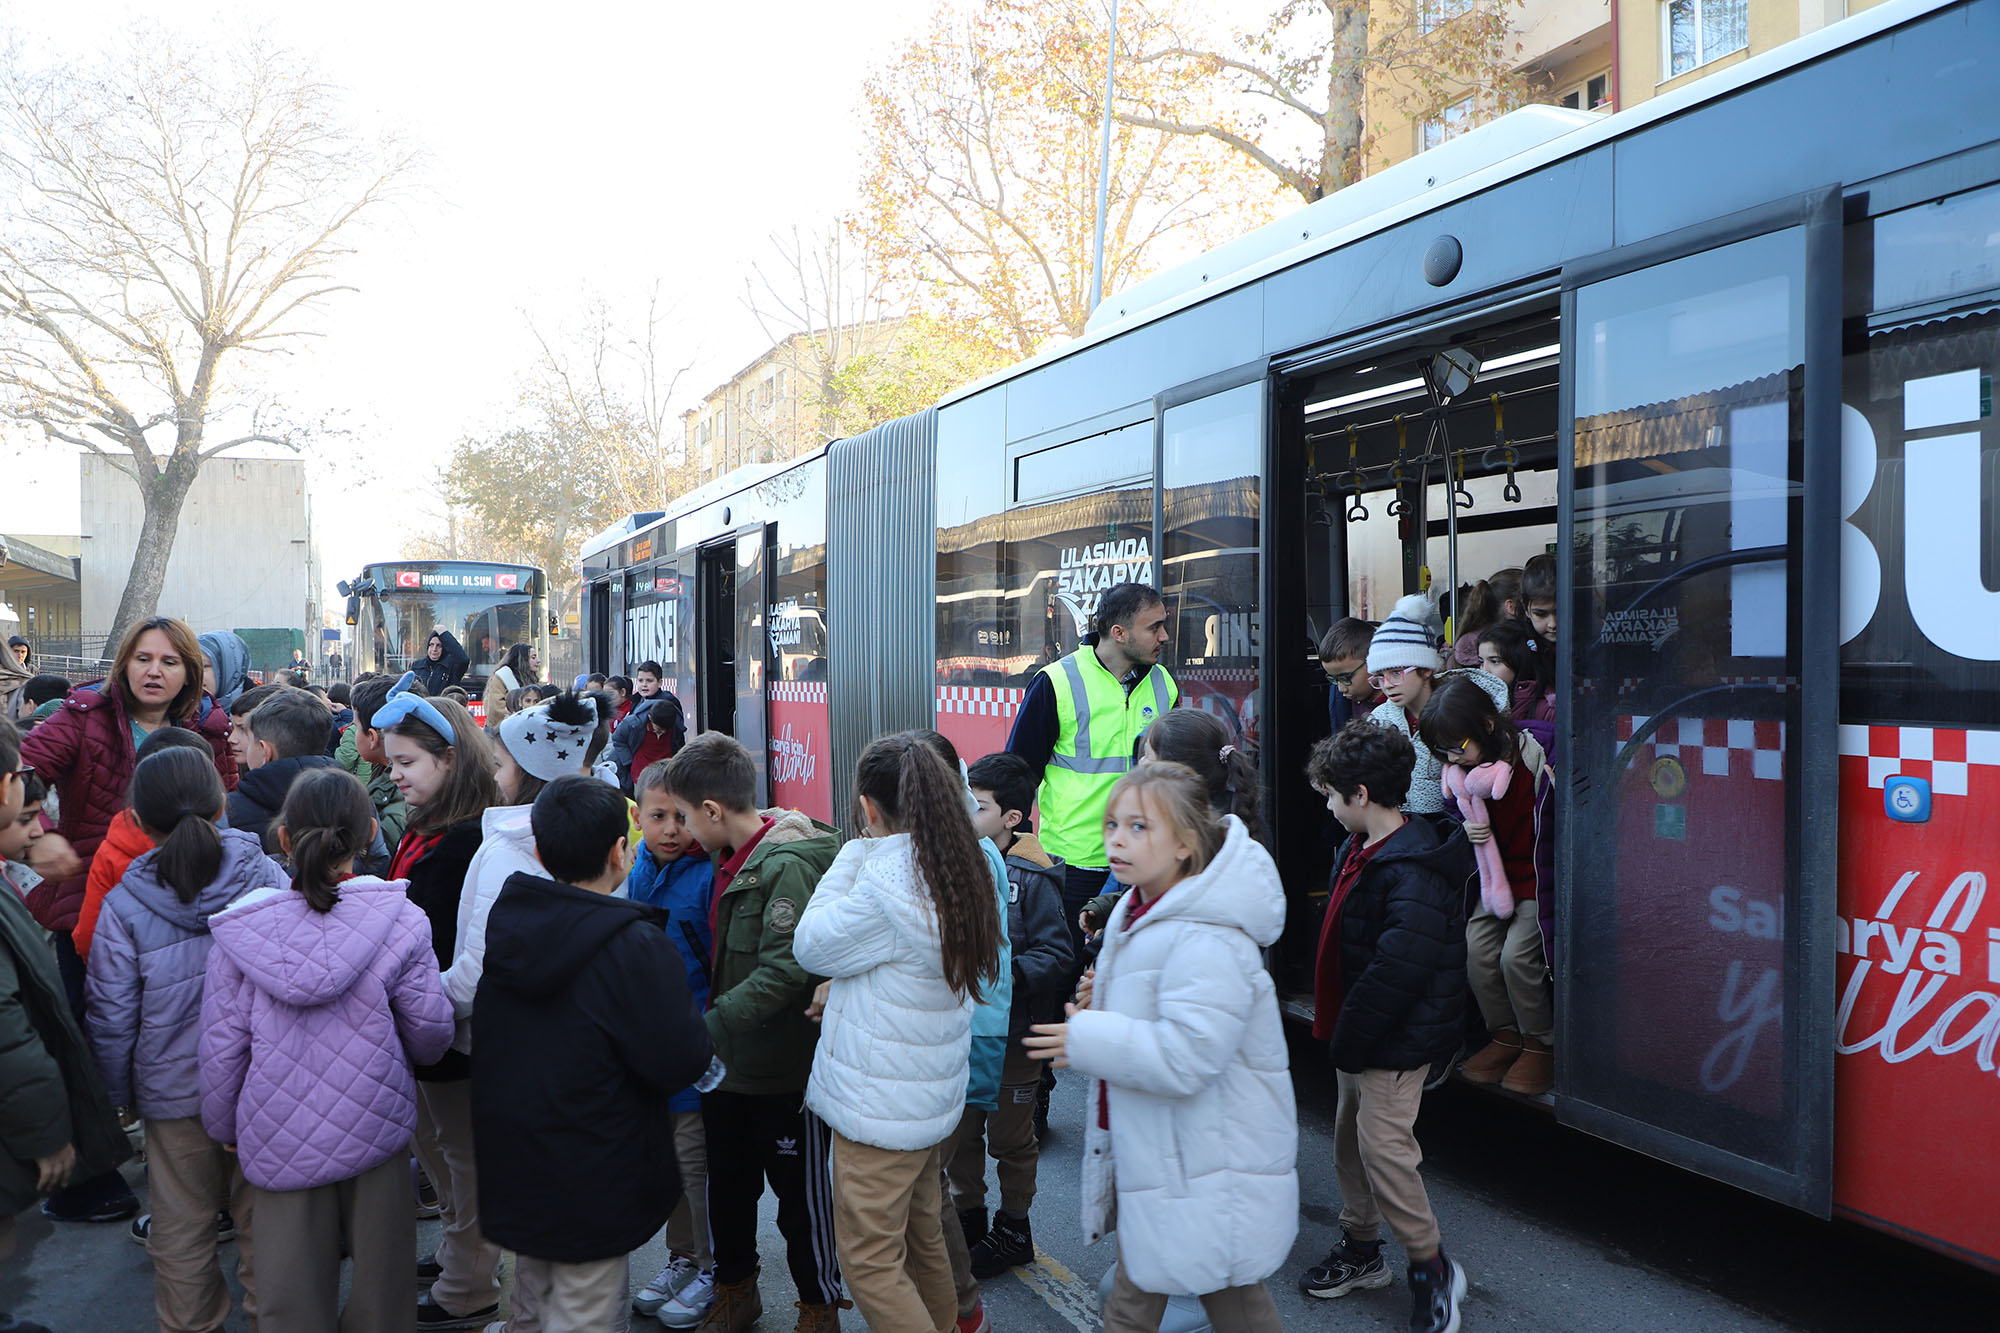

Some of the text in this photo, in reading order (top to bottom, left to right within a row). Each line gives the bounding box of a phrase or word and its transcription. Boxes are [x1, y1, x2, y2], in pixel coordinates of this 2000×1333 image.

[422, 575, 492, 586] HAYIRLI OLSUN
[1058, 561, 1153, 594] SAKARYA
[769, 736, 790, 757] akarya
[769, 721, 816, 787] ollarda
